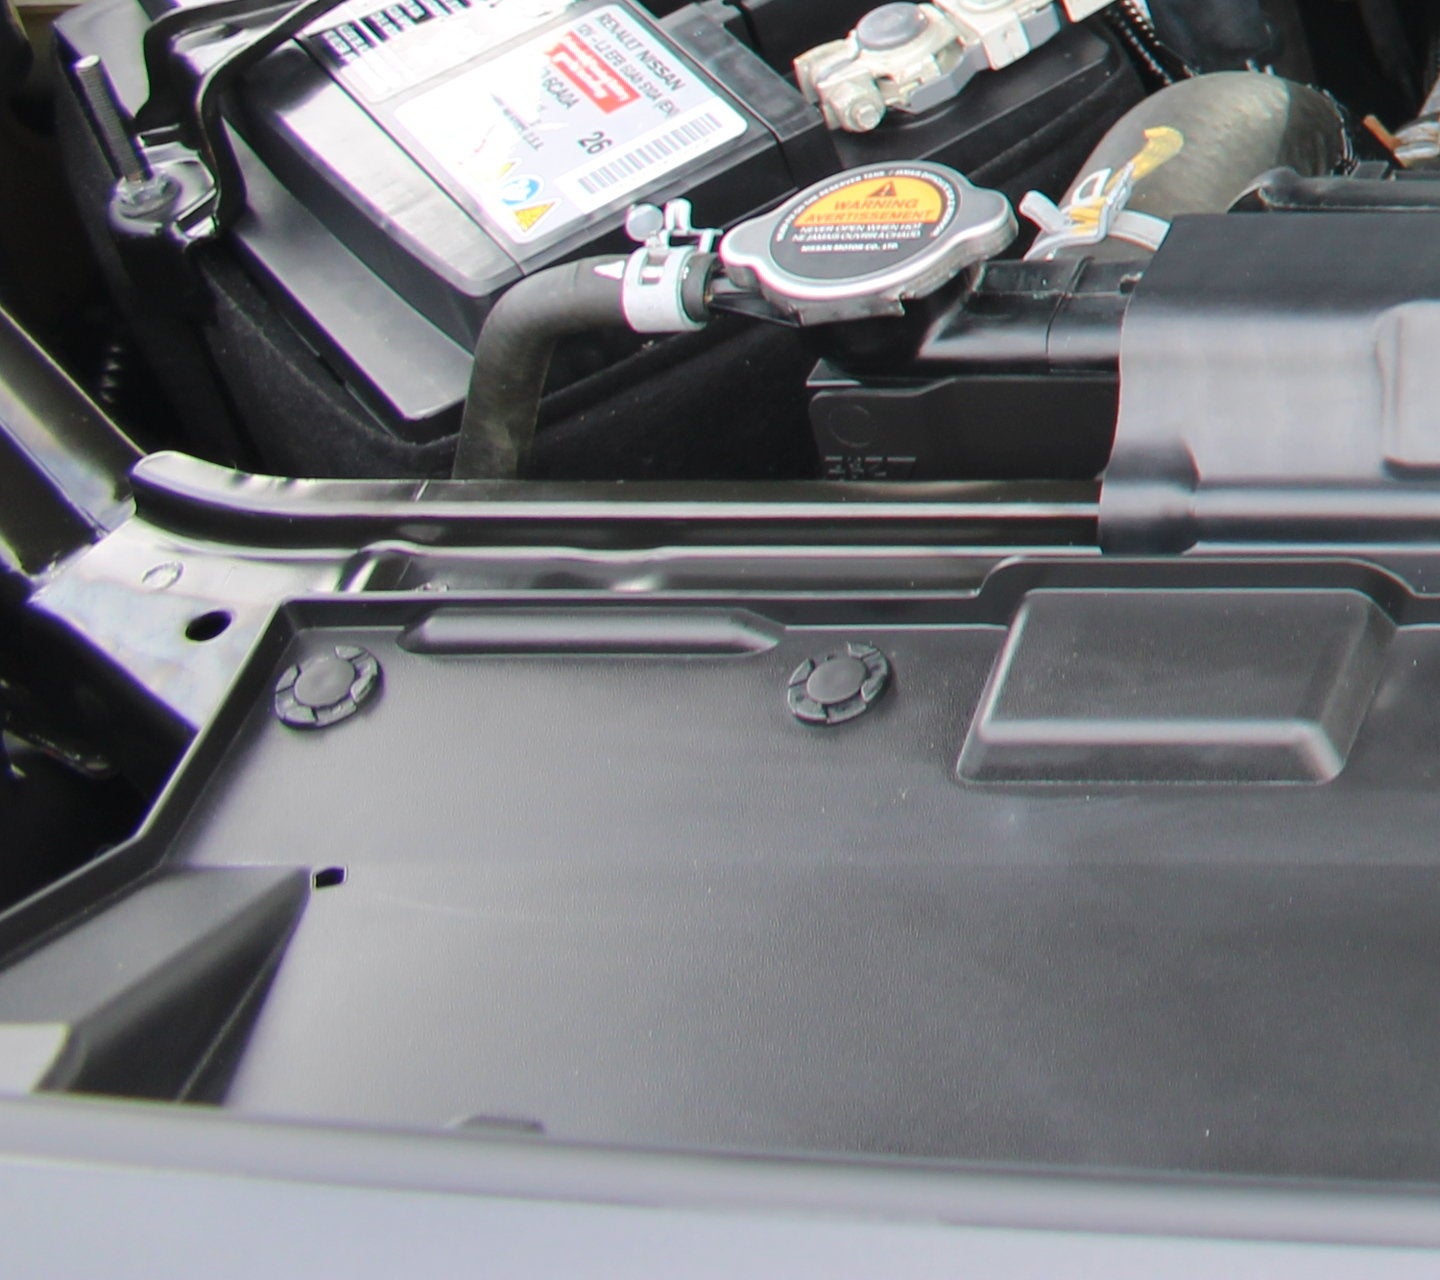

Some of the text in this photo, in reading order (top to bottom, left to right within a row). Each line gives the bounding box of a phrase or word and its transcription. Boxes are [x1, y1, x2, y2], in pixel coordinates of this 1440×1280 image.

[597, 13, 643, 50] RENAULT
[636, 50, 685, 90] NISSAN
[578, 131, 612, 155] 26
[834, 199, 918, 209] WARNING
[804, 210, 934, 222] AVERTISSEMENT
[867, 223, 898, 231] WHEN
[801, 244, 832, 252] NISSAN
[833, 243, 863, 251] MOTOR
